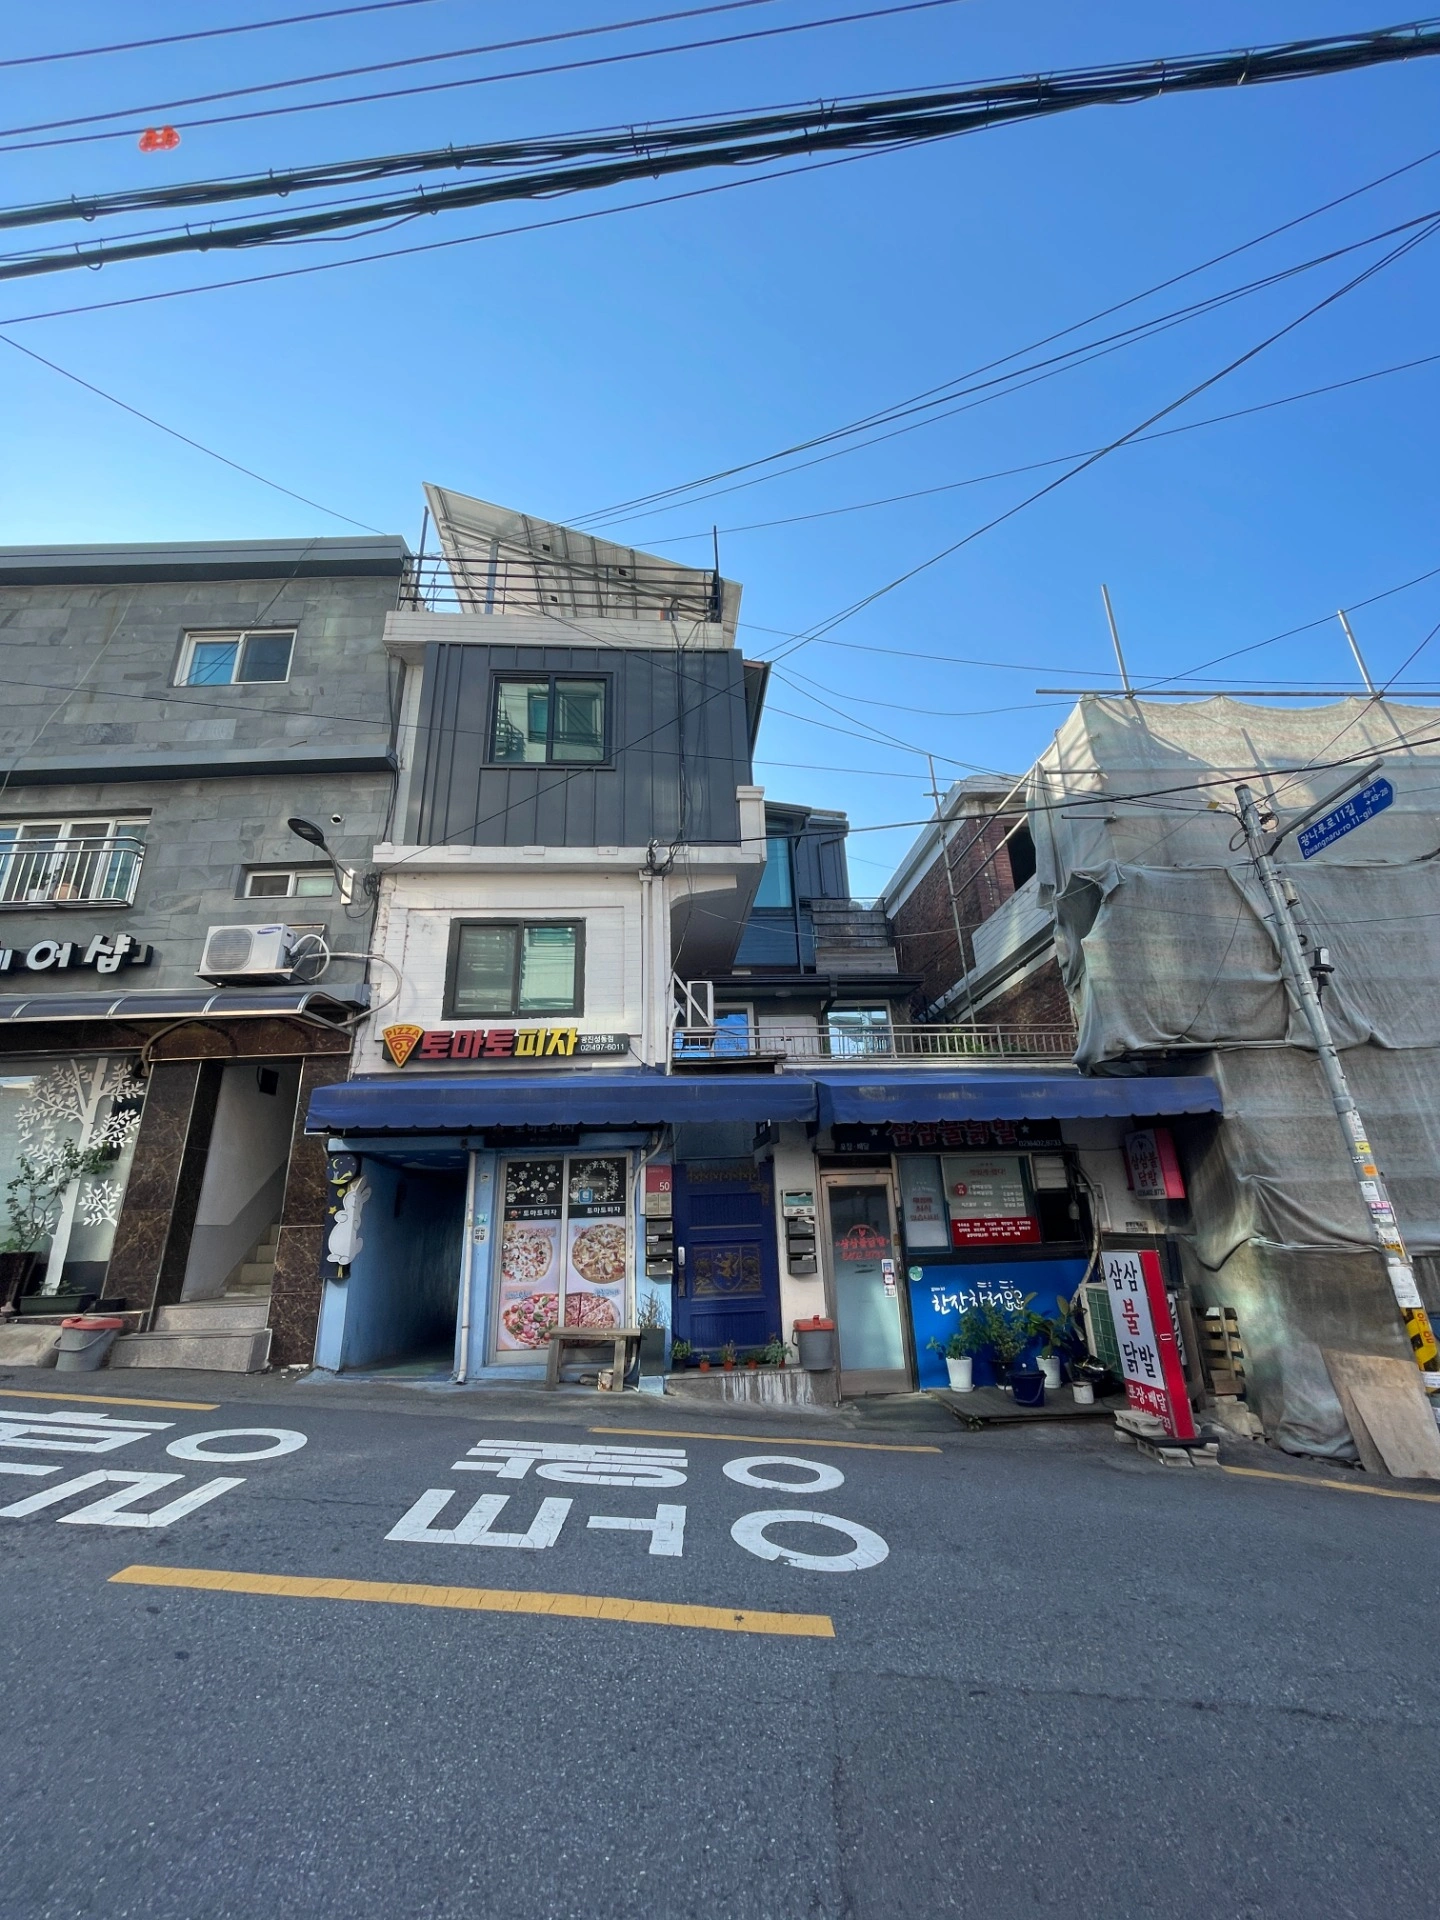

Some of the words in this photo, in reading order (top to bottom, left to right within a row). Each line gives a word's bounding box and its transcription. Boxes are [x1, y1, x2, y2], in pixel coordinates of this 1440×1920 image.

[1301, 803, 1356, 846] 광나루로11길
[1304, 823, 1351, 856] Gwangnaru-ro
[1352, 807, 1373, 826] 11-gil
[386, 1026, 420, 1039] PIZZA
[419, 1028, 578, 1059] 토마토피자
[581, 1035, 614, 1044] 광진성동점
[581, 1043, 625, 1052] 02)497-6011
[1131, 1151, 1158, 1170] 삼삼불
[659, 1181, 670, 1191] 50
[1138, 1169, 1158, 1187] 닭발
[1109, 1260, 1138, 1292] 삼삼
[1122, 1299, 1140, 1336] 불
[1123, 1341, 1156, 1378] 닭발
